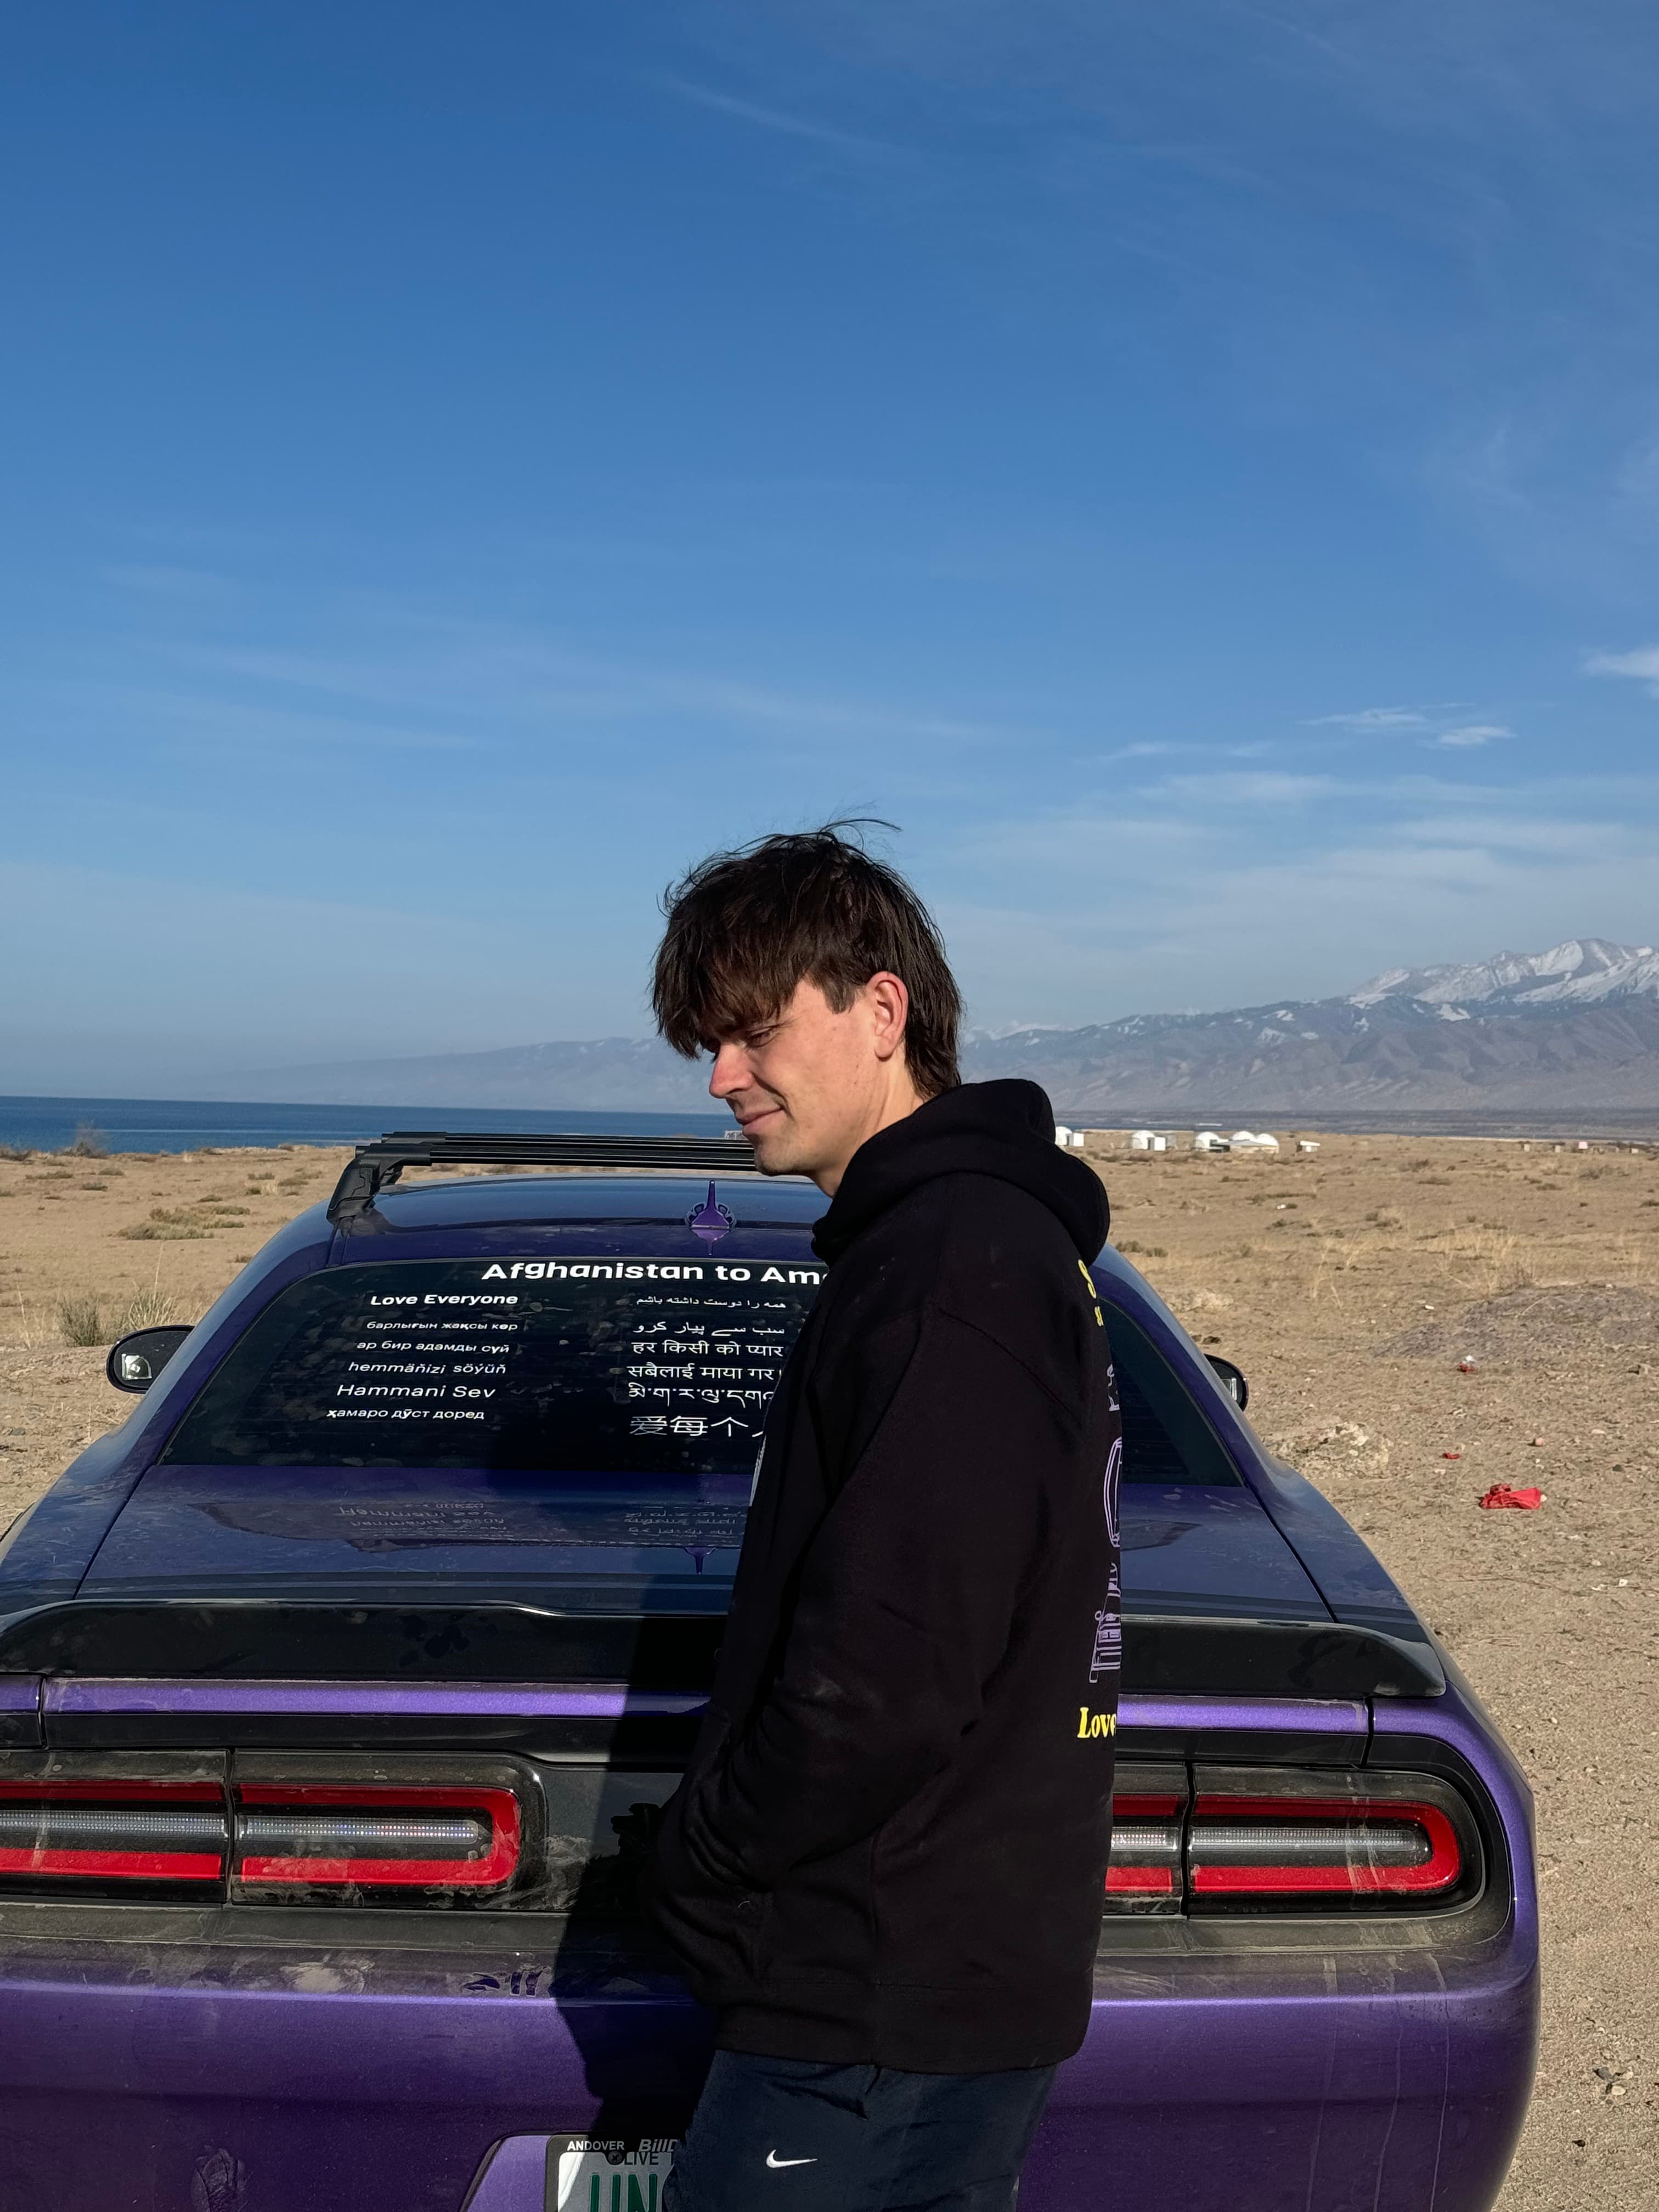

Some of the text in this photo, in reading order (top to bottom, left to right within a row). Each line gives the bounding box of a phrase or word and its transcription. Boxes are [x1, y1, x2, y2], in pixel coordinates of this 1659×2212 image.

[481, 1262, 828, 1285] Afghanistan to Am
[370, 1294, 518, 1306] Love Everyone
[703, 1299, 742, 1308] دوست
[747, 1300, 760, 1309] را
[633, 1321, 667, 1333] کرو
[674, 1322, 705, 1335] پیار
[711, 1327, 746, 1336] سے
[357, 1342, 377, 1350] ар
[381, 1340, 412, 1351] бир
[415, 1343, 477, 1352] адамды
[631, 1339, 784, 1357] हर किसी को प्यार
[627, 1362, 695, 1379] सबैलाई
[699, 1367, 743, 1379] माया
[337, 1384, 496, 1398] Hammani Sev
[432, 1411, 484, 1420] доред
[567, 2141, 625, 2151] ANDOVER
[624, 2152, 659, 2165] LIVE
